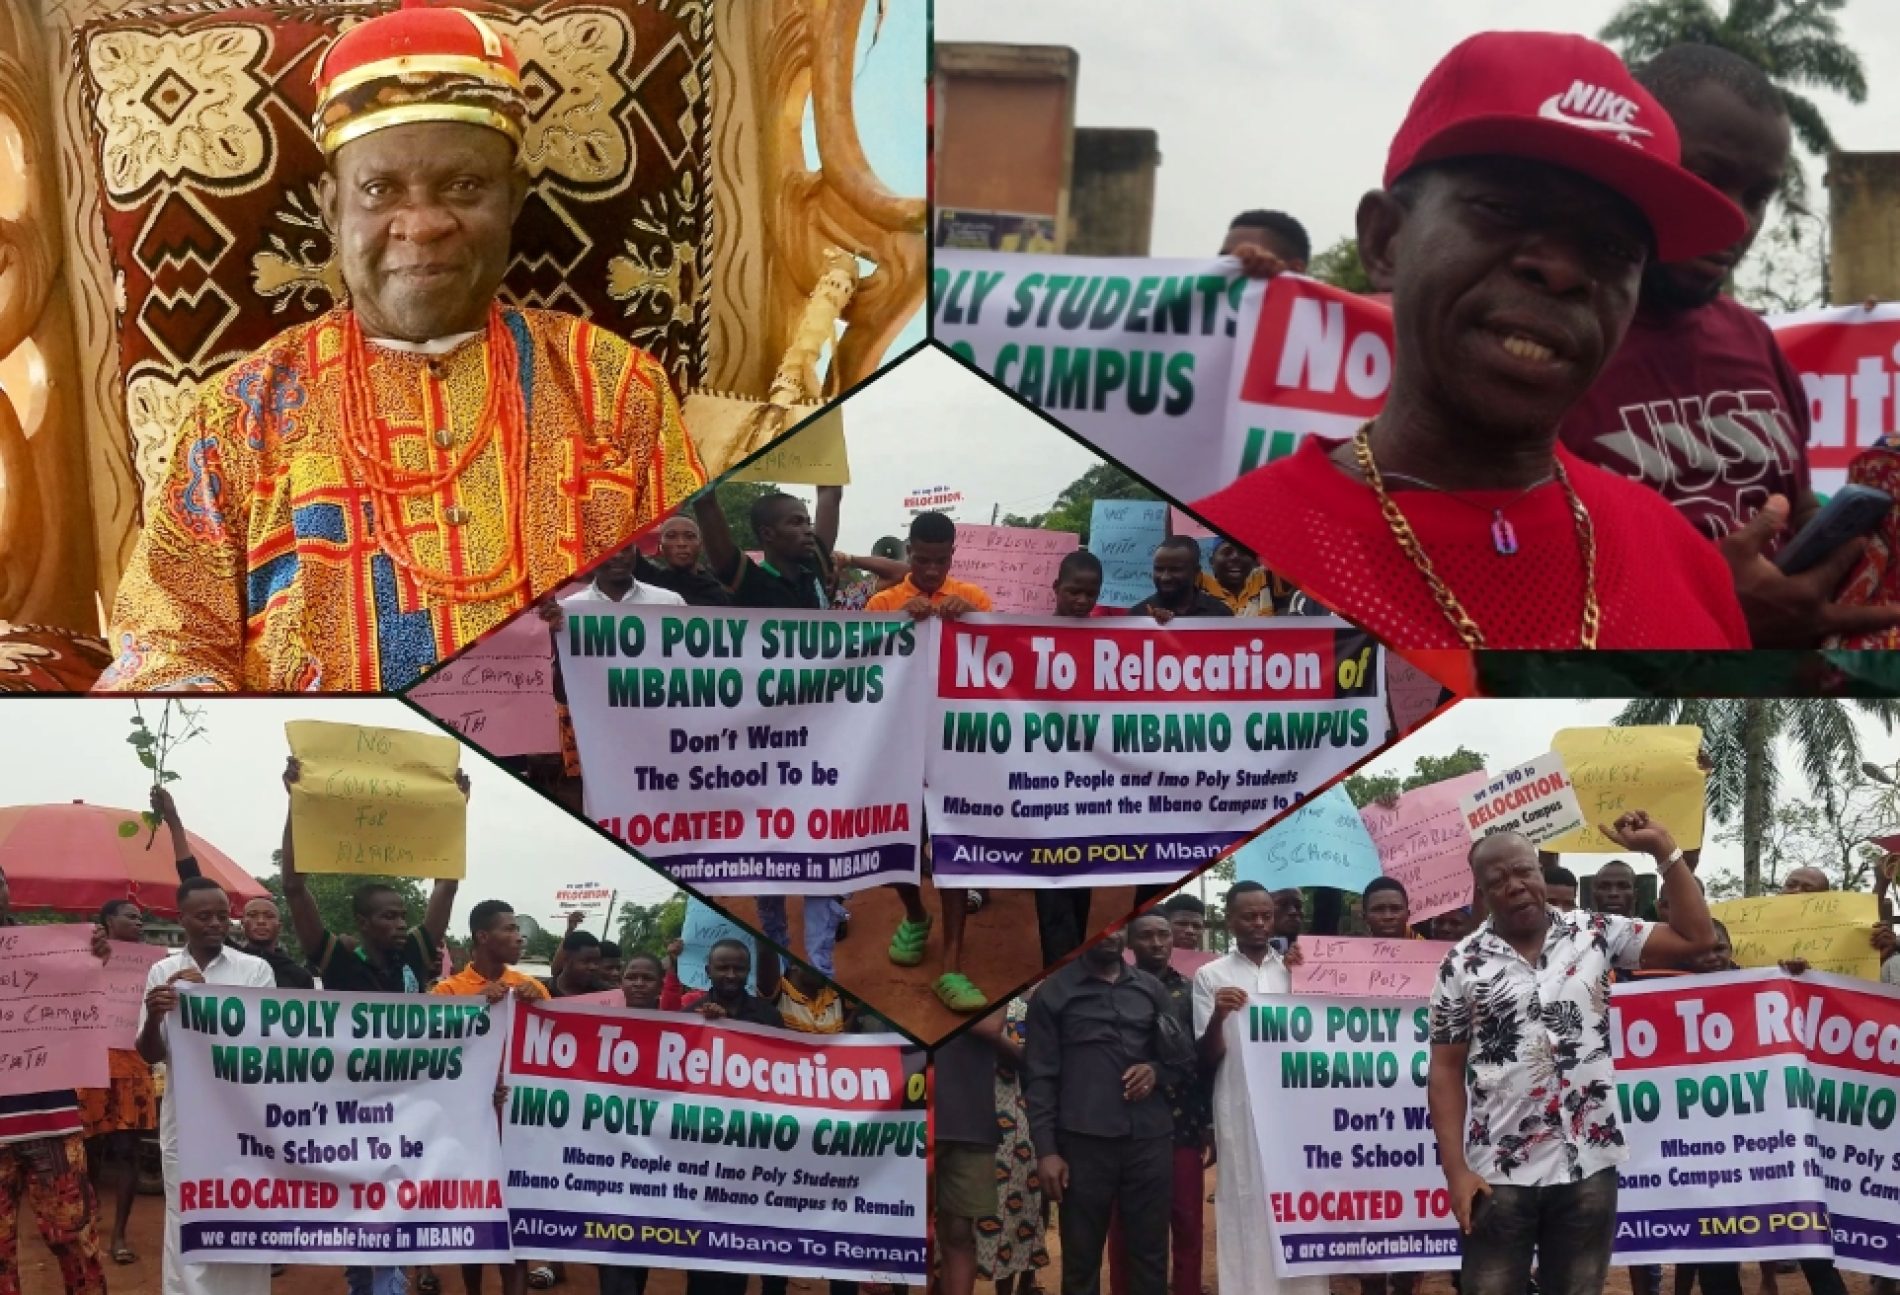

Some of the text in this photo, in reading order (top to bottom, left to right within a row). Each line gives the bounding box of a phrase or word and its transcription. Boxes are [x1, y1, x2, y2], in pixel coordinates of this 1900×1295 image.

[1560, 79, 1639, 122] NIKE
[1276, 297, 1392, 399] No
[569, 616, 915, 659] IMO POLY STUDENTS
[955, 632, 1014, 689] No
[1031, 636, 1078, 690] To
[1093, 637, 1321, 692] Relocation
[1338, 646, 1373, 691] of
[608, 665, 884, 708] MBANO CAMPUS
[670, 725, 808, 753] Don't Want
[942, 708, 1369, 754] IMO POLY MBANO CAMPUS
[634, 761, 839, 791] The School To be
[1008, 768, 1298, 793] Mbano People and Imo Poly Students
[1488, 780, 1504, 794] say
[1506, 769, 1522, 785] NO
[1524, 767, 1536, 778] to
[943, 797, 1004, 818] Mbano
[1011, 798, 1070, 823] Campus
[1075, 797, 1112, 816] want
[1117, 796, 1143, 816] the
[1148, 795, 1203, 814] Mbano
[1209, 795, 1268, 818] Campus
[1272, 794, 1289, 811] to
[1466, 771, 1571, 830] RELOCATION.
[1521, 801, 1563, 824] Campus
[756, 808, 795, 840] TO
[808, 803, 909, 840] OMUMA
[664, 851, 880, 883] omfortable here in MBANO
[953, 844, 1024, 865] Allow
[1030, 848, 1082, 865] IMO
[1087, 844, 1149, 863] POLY
[179, 993, 491, 1040] IMO POLY STUDENTS
[1249, 1006, 1314, 1042] IMO
[1326, 1007, 1401, 1043] POLY
[1675, 999, 1734, 1052] To
[211, 1044, 463, 1085] MBANO CAMPUS
[522, 1013, 577, 1069] No
[597, 1025, 639, 1076] To
[656, 1030, 891, 1101] Relocation
[1281, 1051, 1399, 1088] MBANO
[1675, 1070, 1769, 1119] POLY
[265, 1100, 395, 1128] Don't Want
[510, 1086, 927, 1159] IMO POLY MBANO CAMPUS
[1333, 1107, 1395, 1131] Don't
[237, 1133, 424, 1164] The School To be
[1303, 1143, 1425, 1169] The School
[1660, 1138, 1726, 1159] Mbano
[1733, 1130, 1796, 1153] People
[1844, 1145, 1884, 1171] Poly
[562, 1147, 860, 1190] Mbano People and Imo Poly Students
[1668, 1161, 1795, 1188] Campus want
[179, 1178, 503, 1212] RELOCATED TO OMUMA
[507, 1170, 916, 1218] Mbano Campus want the Mbano Campus to Remain
[1414, 1188, 1451, 1218] TO
[201, 1226, 475, 1249] we are comfortable here in MBANO
[513, 1217, 577, 1237] Allow
[583, 1221, 635, 1241] IMO
[640, 1227, 702, 1246] POLY
[708, 1232, 793, 1254] Mbano
[798, 1237, 827, 1256] To
[1616, 1221, 1691, 1239] Allow
[1699, 1215, 1761, 1235] IMO
[1299, 1234, 1458, 1258] are comfortable here
